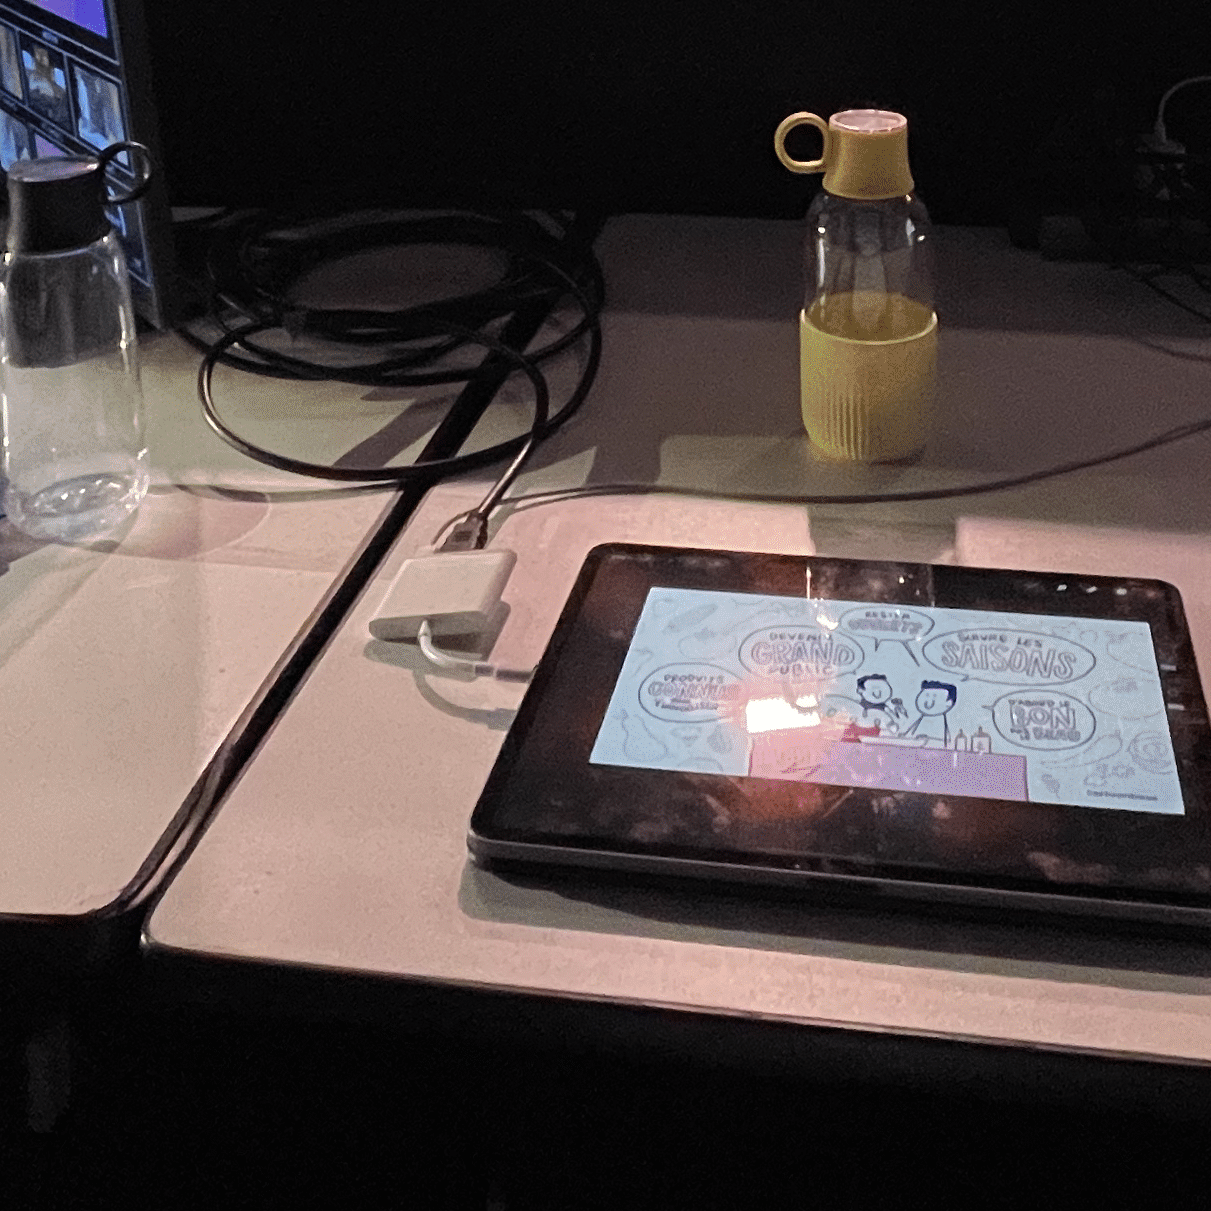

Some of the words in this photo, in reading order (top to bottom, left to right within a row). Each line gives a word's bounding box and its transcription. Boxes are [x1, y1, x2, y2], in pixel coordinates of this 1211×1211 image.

[751, 641, 856, 666] GRAND
[941, 640, 1077, 680] SAISONS
[1009, 705, 1077, 730] BON
